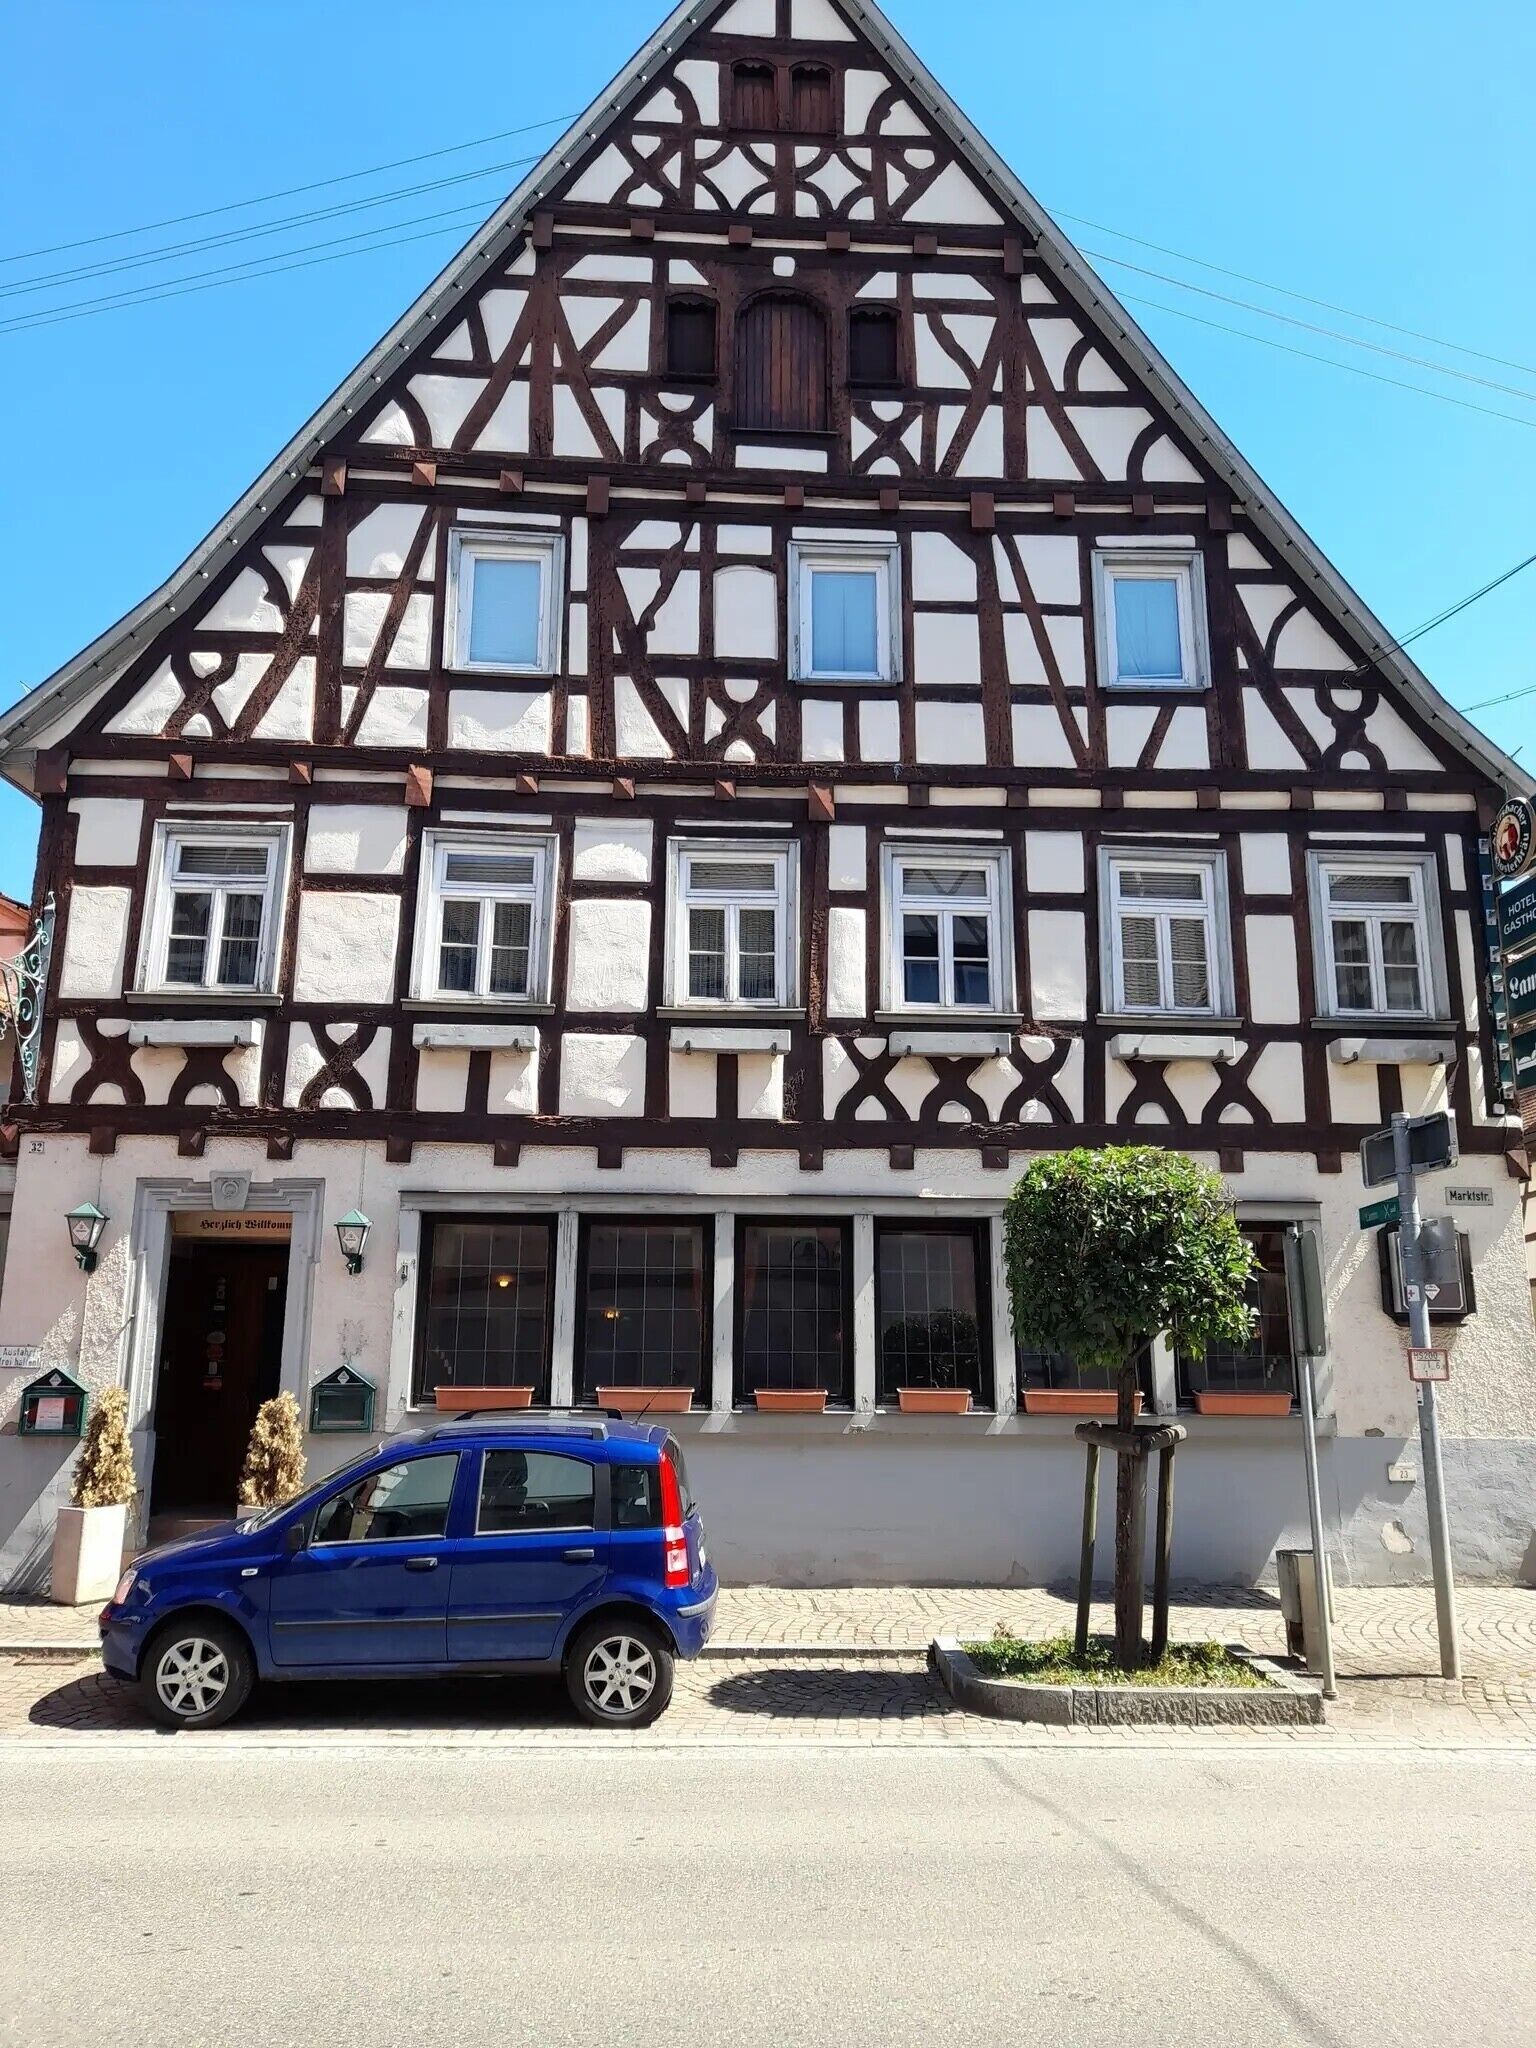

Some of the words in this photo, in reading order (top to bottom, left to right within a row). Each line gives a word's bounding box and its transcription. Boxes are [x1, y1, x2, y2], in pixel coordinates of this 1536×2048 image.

[1508, 893, 1536, 917] HOTEL
[31, 1142, 43, 1152] 32
[1449, 1190, 1491, 1202] Marktstr.
[200, 1219, 242, 1231] Herzlich
[0, 1357, 12, 1366] rei
